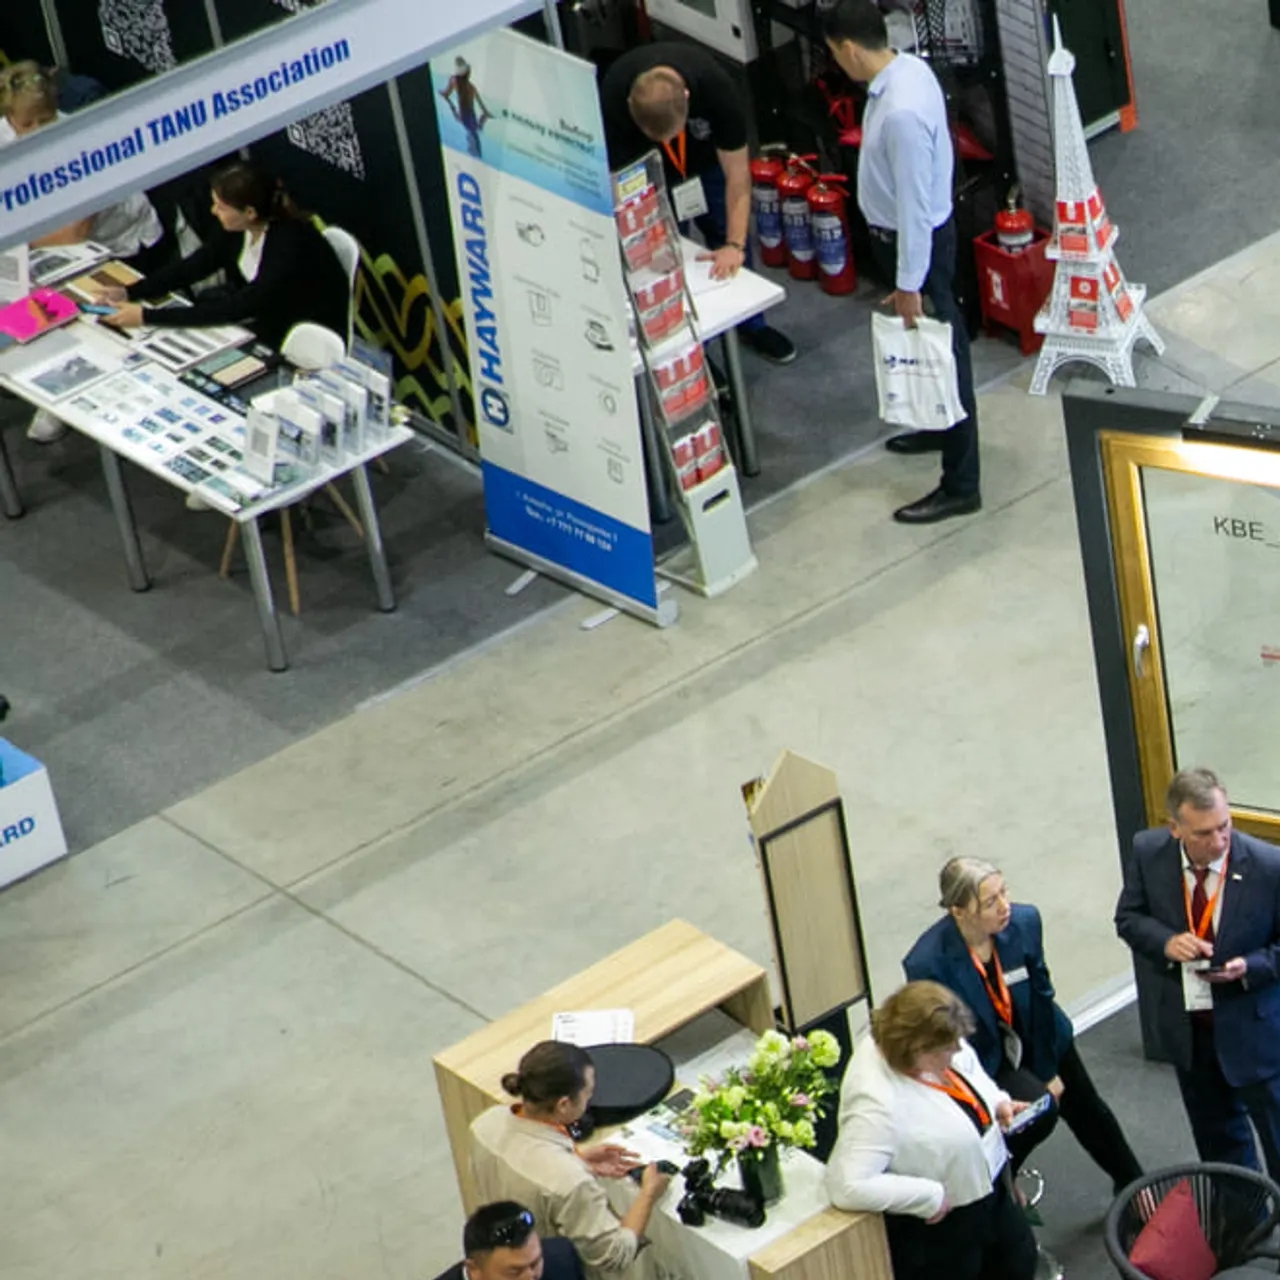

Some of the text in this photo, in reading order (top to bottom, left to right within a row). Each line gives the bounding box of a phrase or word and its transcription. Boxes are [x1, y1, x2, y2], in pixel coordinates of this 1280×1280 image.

[0, 38, 351, 212] rofessional TANU Association
[457, 171, 504, 385] HAYWARD
[0, 815, 36, 849] RD
